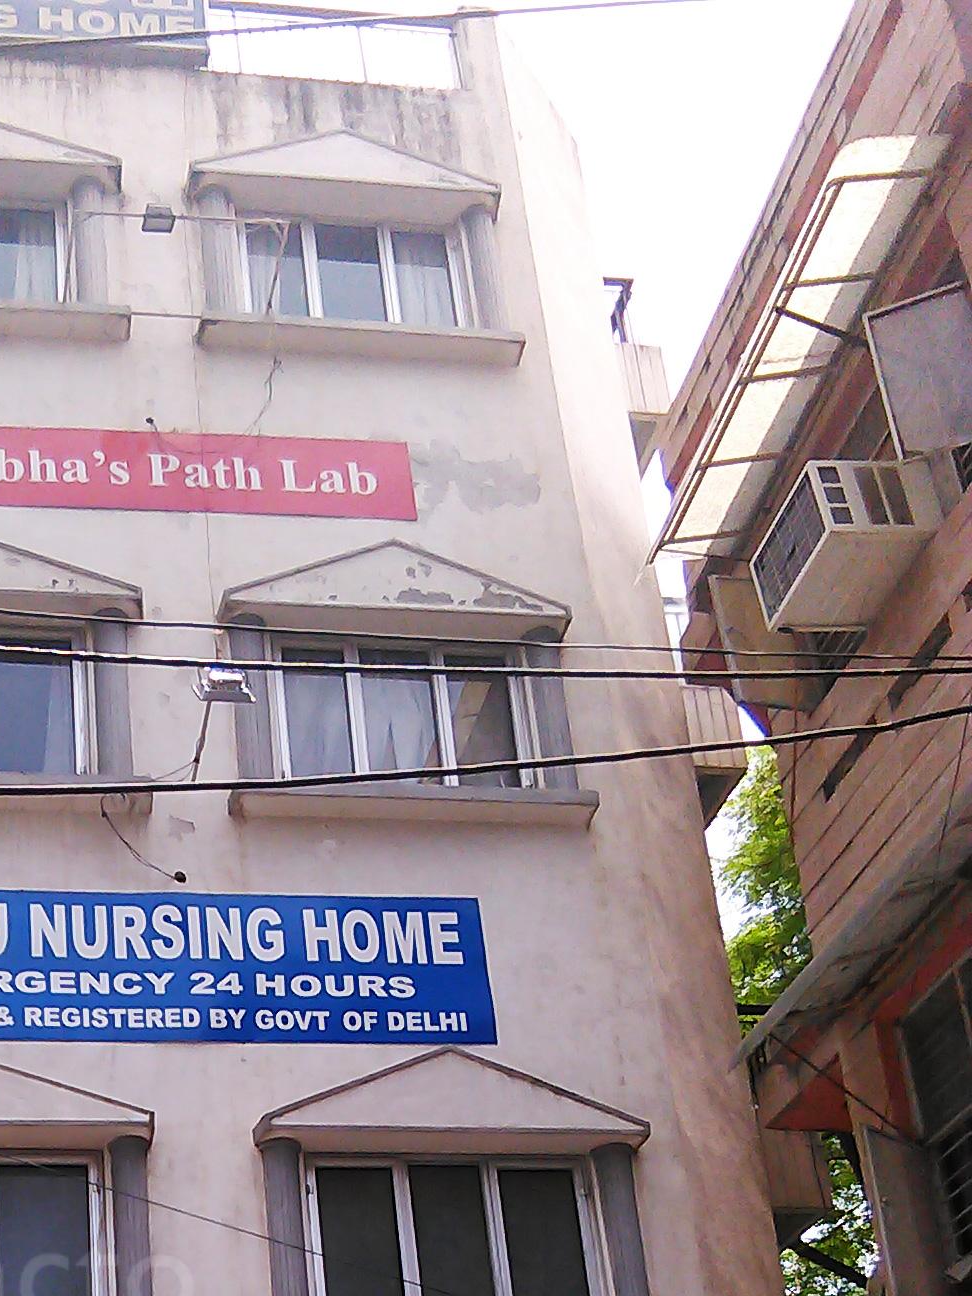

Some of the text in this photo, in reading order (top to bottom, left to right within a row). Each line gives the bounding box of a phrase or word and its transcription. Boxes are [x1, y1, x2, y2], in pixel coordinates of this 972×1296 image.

[38, 7, 195, 36] HOME
[148, 452, 264, 491] Path
[280, 458, 378, 496] Lab
[29, 903, 286, 964] NURSING
[303, 910, 465, 966] HOME
[190, 971, 244, 996] 24
[256, 973, 417, 999] HOURS
[24, 1007, 204, 1030] REGISTERED
[210, 1010, 246, 1031] BY
[255, 1010, 331, 1033] GOVT
[343, 1011, 381, 1034] OF
[387, 1011, 469, 1034] DELHI
